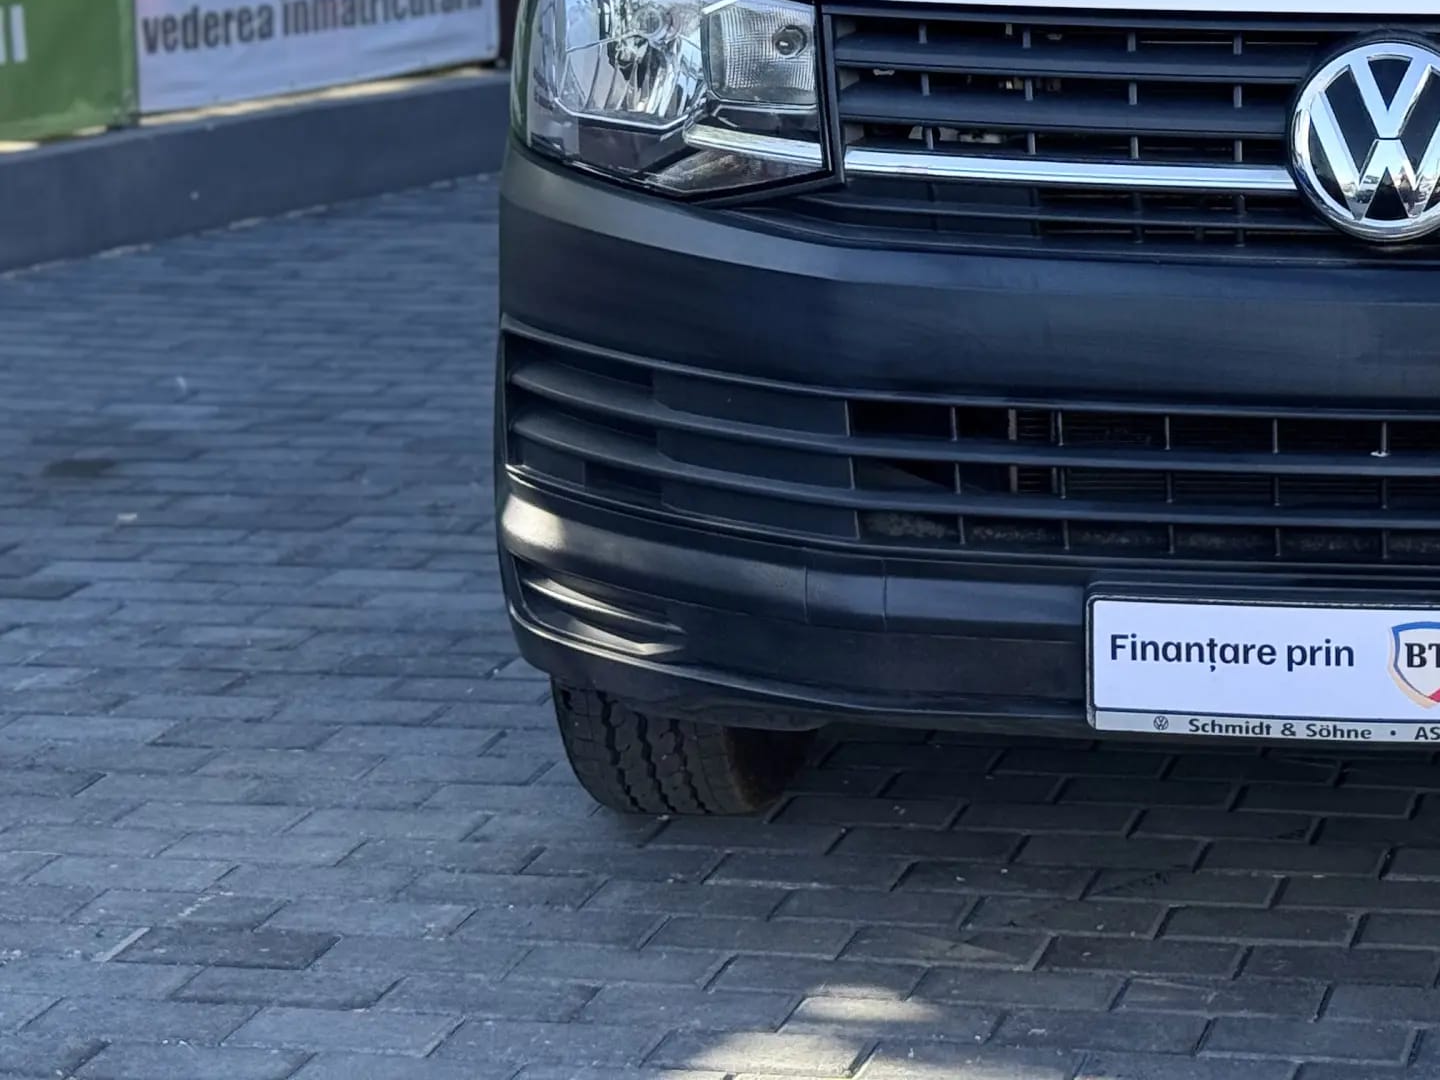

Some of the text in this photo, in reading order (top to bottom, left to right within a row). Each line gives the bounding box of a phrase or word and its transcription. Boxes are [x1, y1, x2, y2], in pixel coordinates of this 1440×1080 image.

[141, 4, 275, 56] vederea
[1110, 632, 1277, 672] Finanțare
[1286, 638, 1355, 672] prin
[1188, 718, 1272, 737] Schmidt
[1280, 722, 1297, 737] &
[1305, 722, 1373, 740] Söhne
